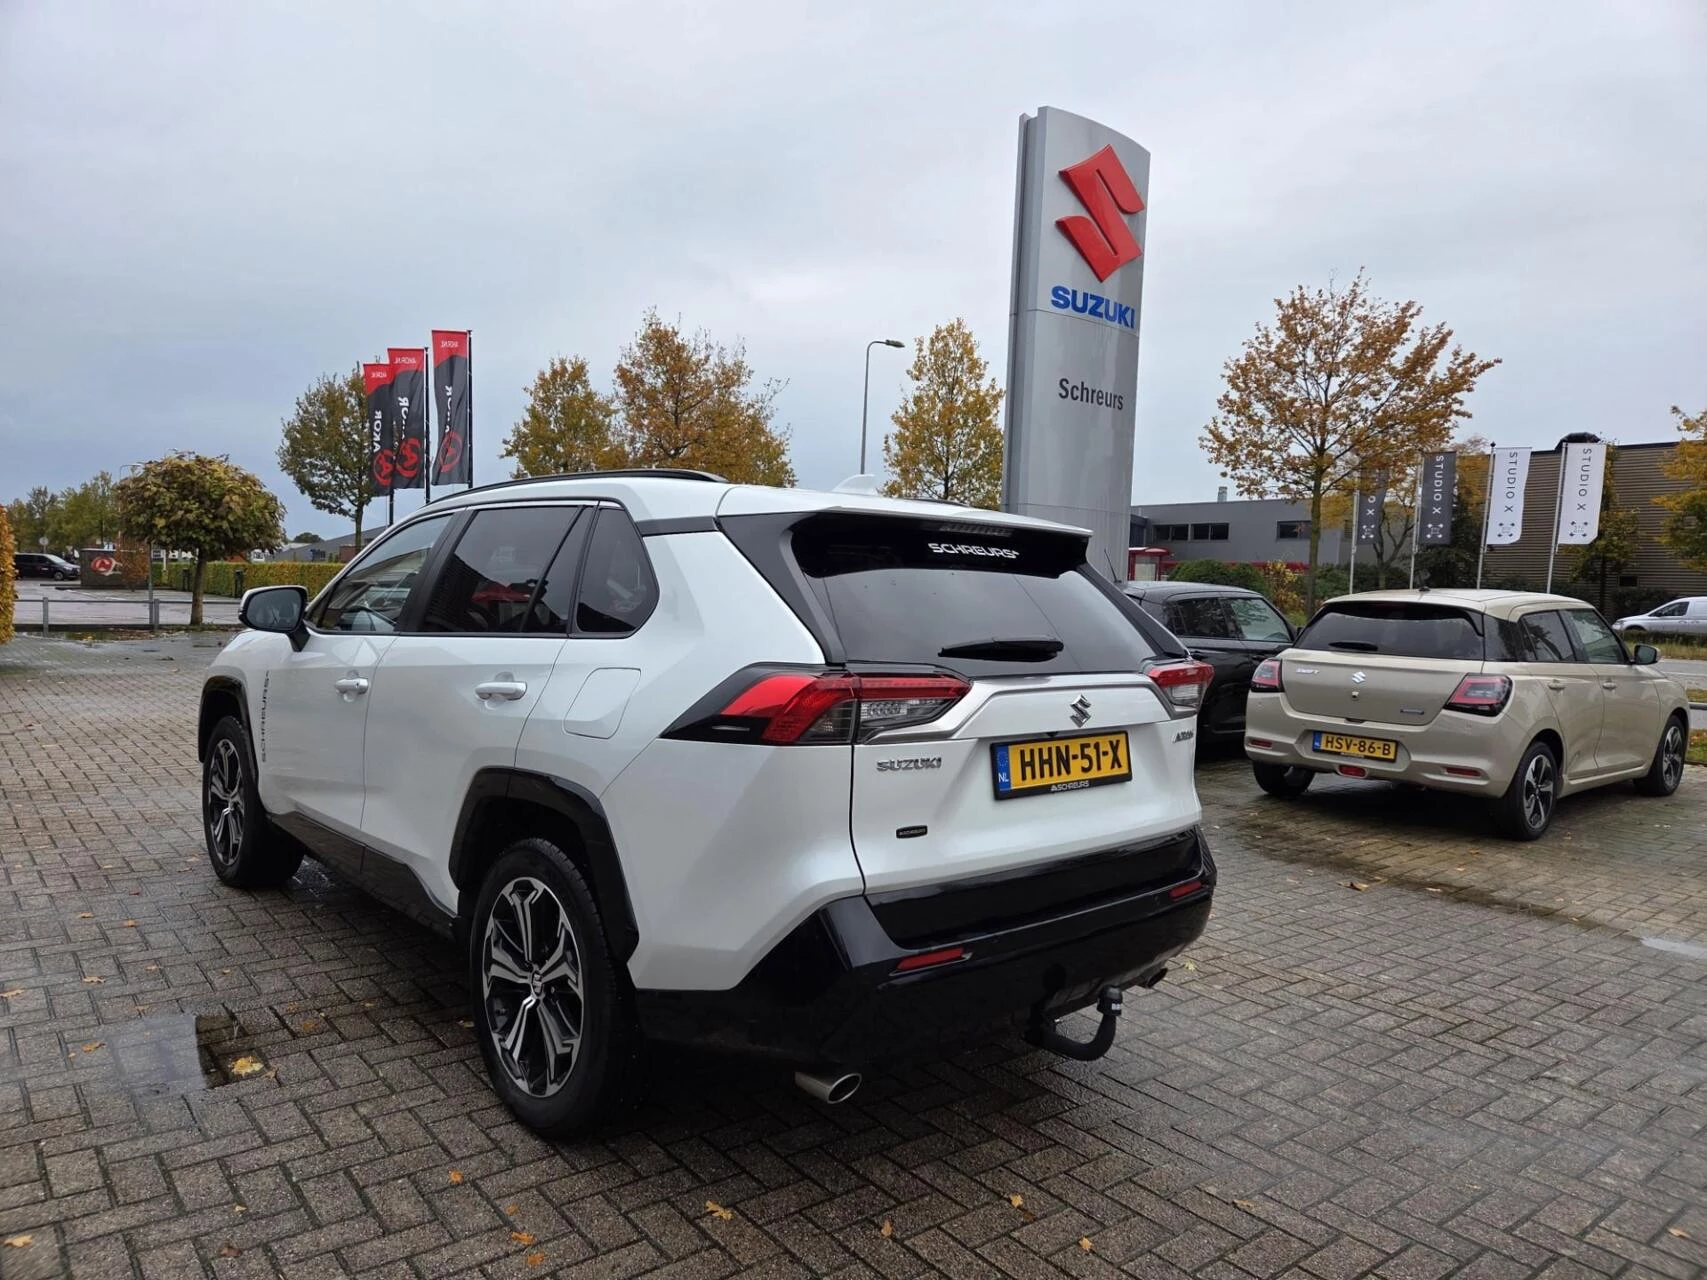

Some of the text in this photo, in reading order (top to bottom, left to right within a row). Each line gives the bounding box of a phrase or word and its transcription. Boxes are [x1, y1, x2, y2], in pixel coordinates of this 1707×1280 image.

[1051, 285, 1135, 329] SUZUKI
[1058, 378, 1124, 410] Schreurs
[1433, 455, 1444, 501] STUDIO
[1505, 451, 1518, 499] STUDIO
[1577, 448, 1592, 511] STUDIO X
[927, 542, 1018, 559] SCHREURS
[877, 757, 942, 771] SUZUKI
[1020, 739, 1122, 781] HHN-51-X
[1325, 735, 1391, 756] HSV-86-B
[998, 772, 1009, 783] NL
